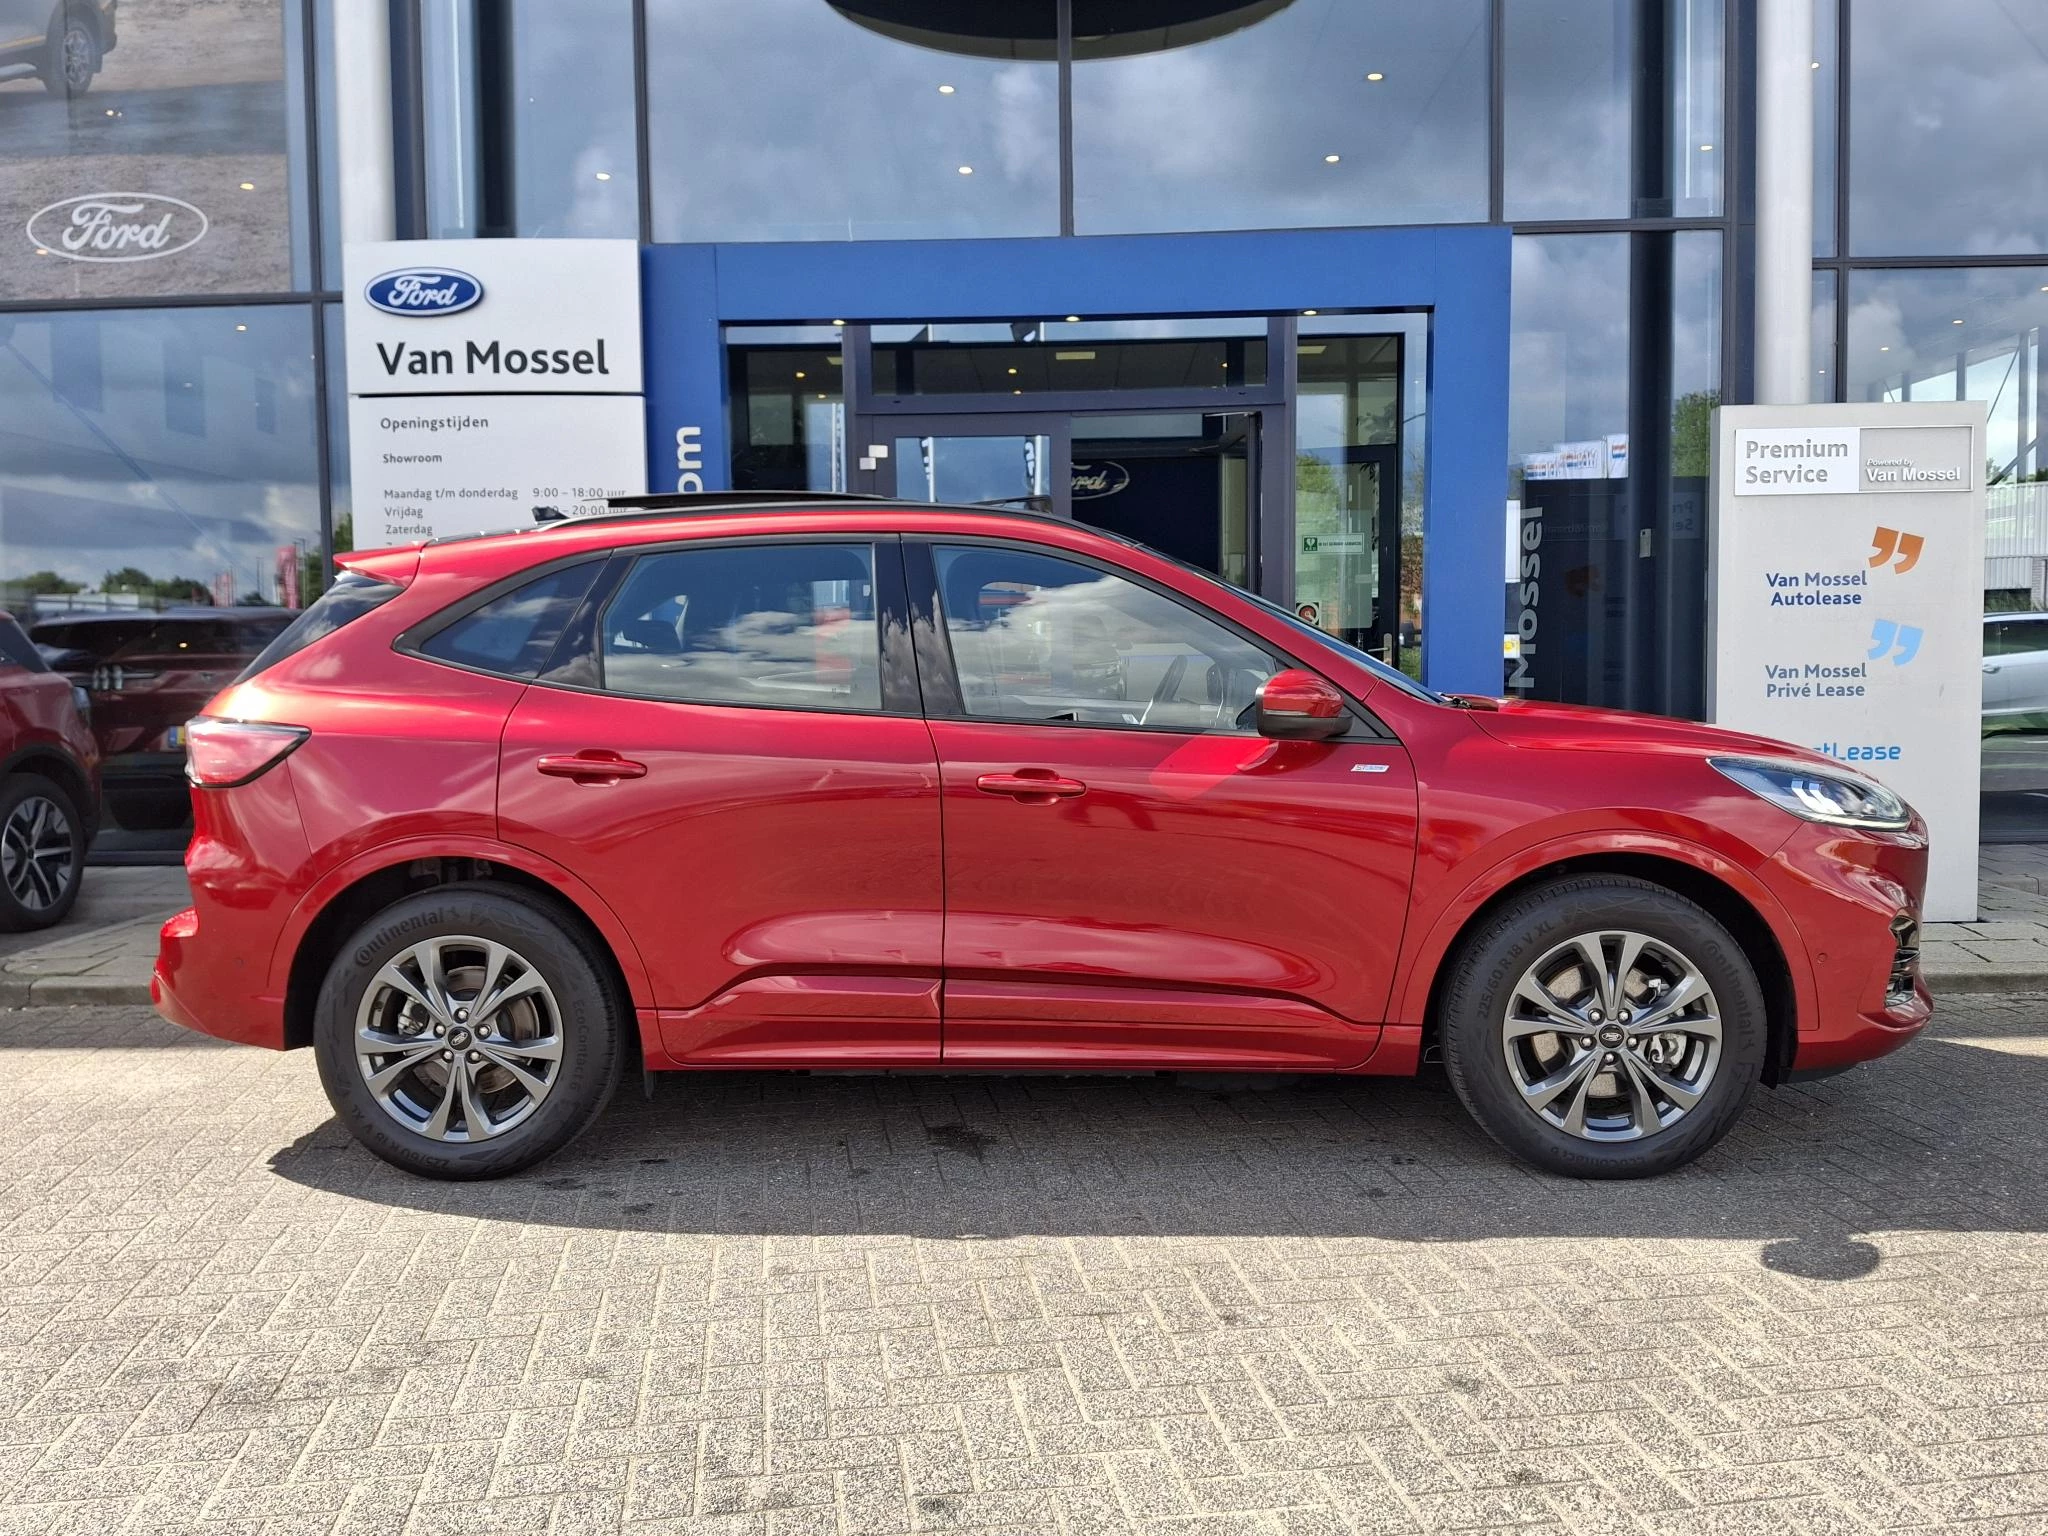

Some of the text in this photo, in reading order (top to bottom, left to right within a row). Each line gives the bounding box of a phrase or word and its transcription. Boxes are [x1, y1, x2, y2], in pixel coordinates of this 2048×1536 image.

[62, 202, 173, 251] Ford
[387, 274, 459, 307] Ford
[376, 338, 610, 376] Van Mossel
[380, 416, 489, 432] Openingstijden
[1745, 438, 1849, 459] Premium
[382, 453, 443, 464] Showroom
[1866, 458, 1914, 467] Powered by
[1745, 464, 1829, 485] Service
[1866, 466, 1961, 482] Van Mossel
[384, 489, 432, 501] Maandag
[435, 488, 455, 499] t/m
[458, 488, 519, 500] donderdag
[531, 487, 559, 498] 9:00
[572, 487, 604, 498] 18:00
[385, 506, 423, 519] Vrijdag
[572, 505, 606, 516] 20:00
[385, 525, 433, 537] Zaterdag
[1766, 570, 1868, 587] Van Mossel
[1508, 506, 1543, 689] Mossel
[1770, 590, 1862, 606] Autolease
[1765, 662, 1867, 679] Van Mossel
[1766, 683, 1865, 698] Privé Lease
[355, 907, 445, 966] Continental
